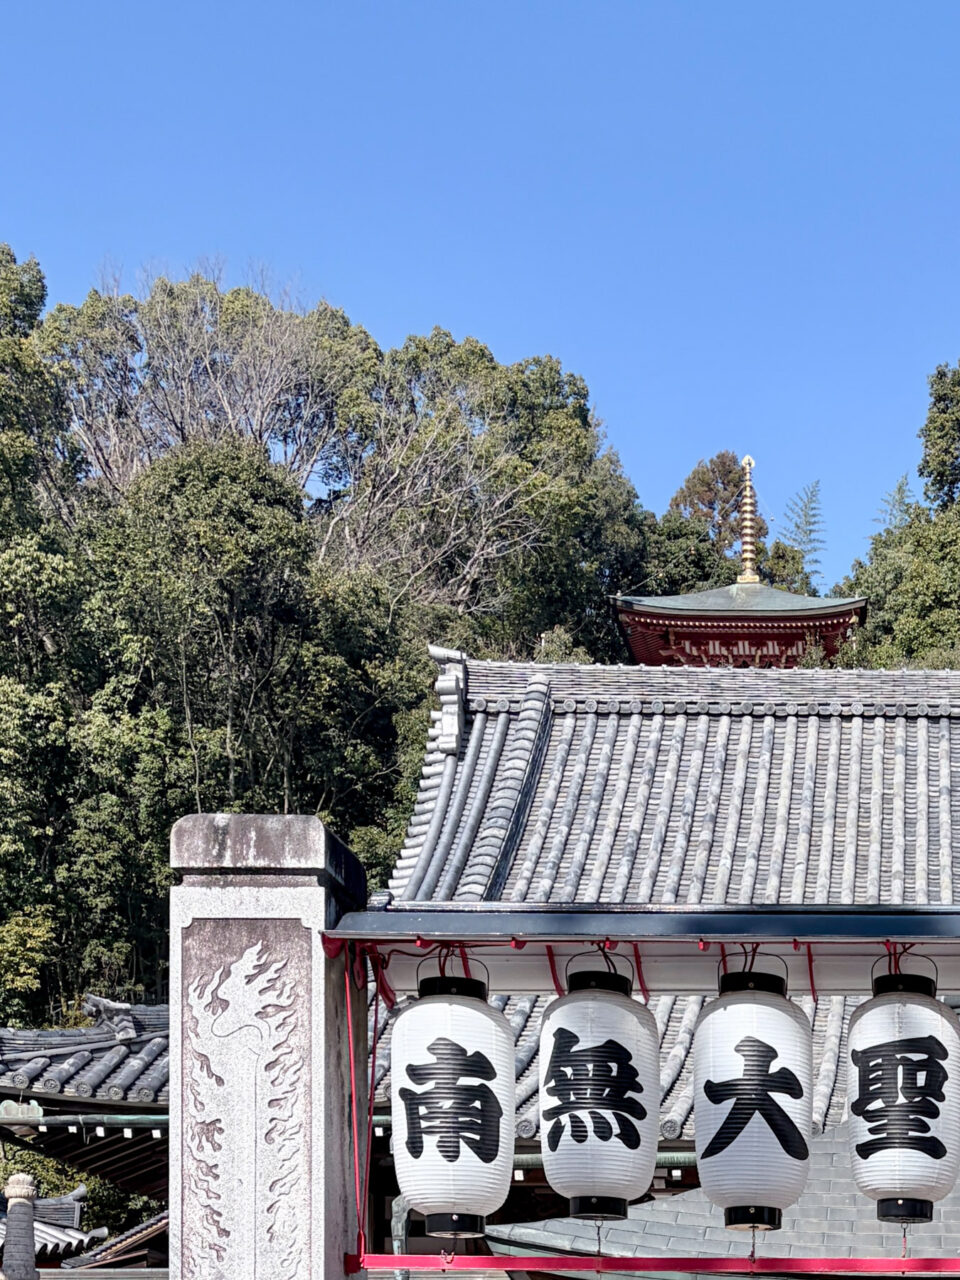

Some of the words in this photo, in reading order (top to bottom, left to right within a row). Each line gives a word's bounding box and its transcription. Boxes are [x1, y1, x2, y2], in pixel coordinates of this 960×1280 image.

[399, 1036, 503, 1164] 南
[543, 1027, 648, 1151] 無
[701, 1035, 809, 1161] 大
[851, 1034, 950, 1160] 聖
